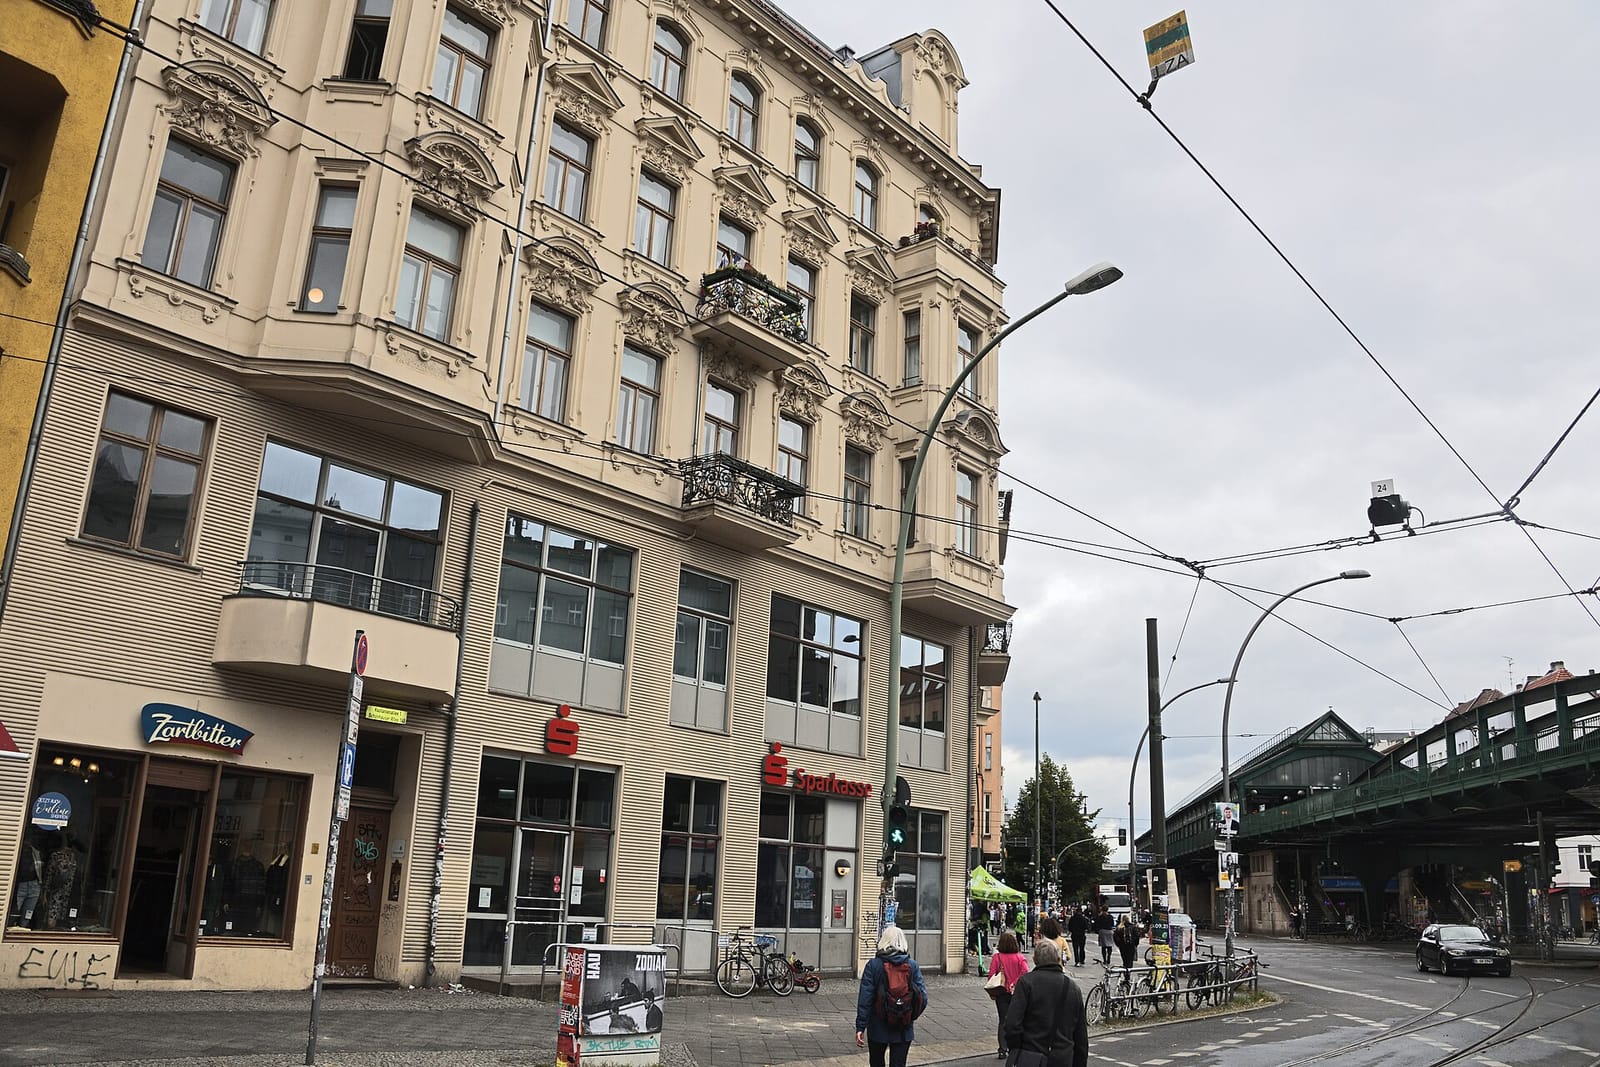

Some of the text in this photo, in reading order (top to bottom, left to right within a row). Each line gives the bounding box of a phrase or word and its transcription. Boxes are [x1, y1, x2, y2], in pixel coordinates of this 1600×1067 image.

[1377, 484, 1387, 493] 24
[148, 712, 242, 749] Zartbitter
[795, 768, 873, 798] Sparkasse
[586, 953, 601, 979] HAU
